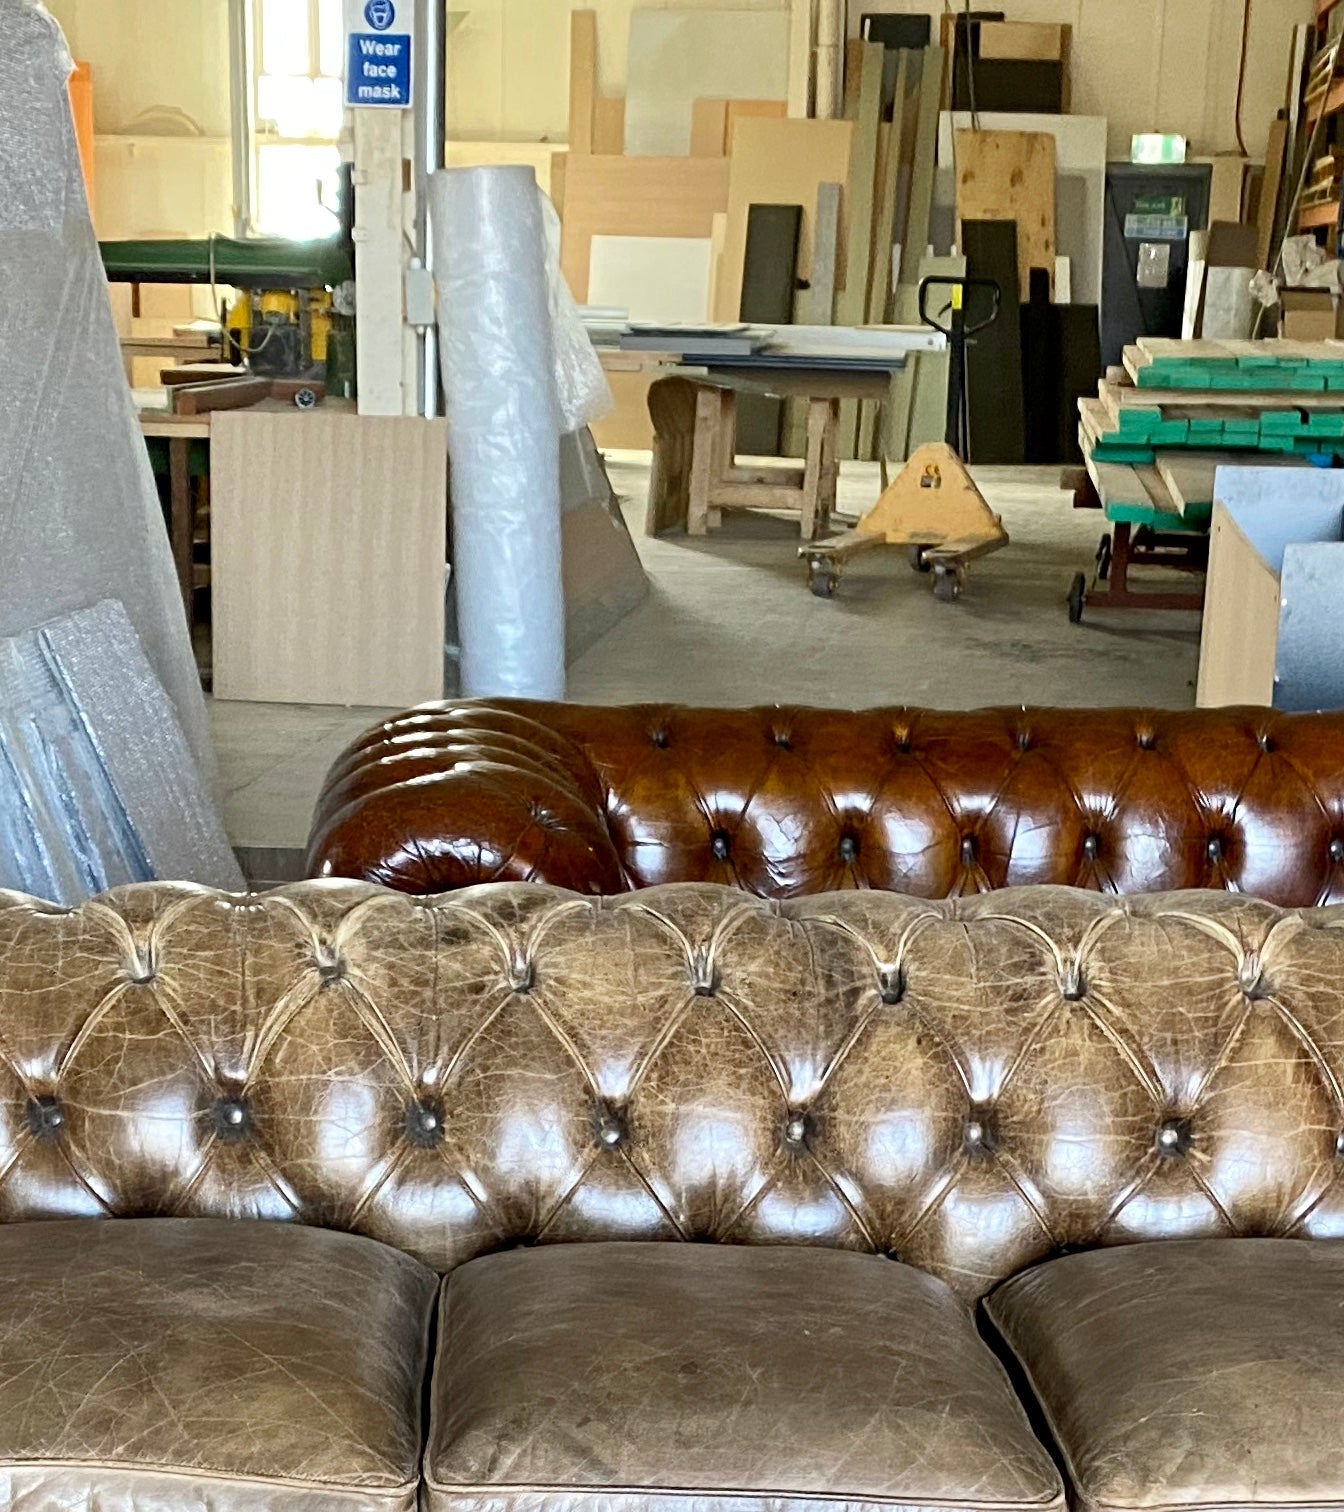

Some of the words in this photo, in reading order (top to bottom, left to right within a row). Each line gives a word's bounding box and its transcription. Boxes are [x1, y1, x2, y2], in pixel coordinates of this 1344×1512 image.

[359, 39, 402, 57] Wear
[363, 61, 398, 78] face
[358, 83, 401, 100] mask
